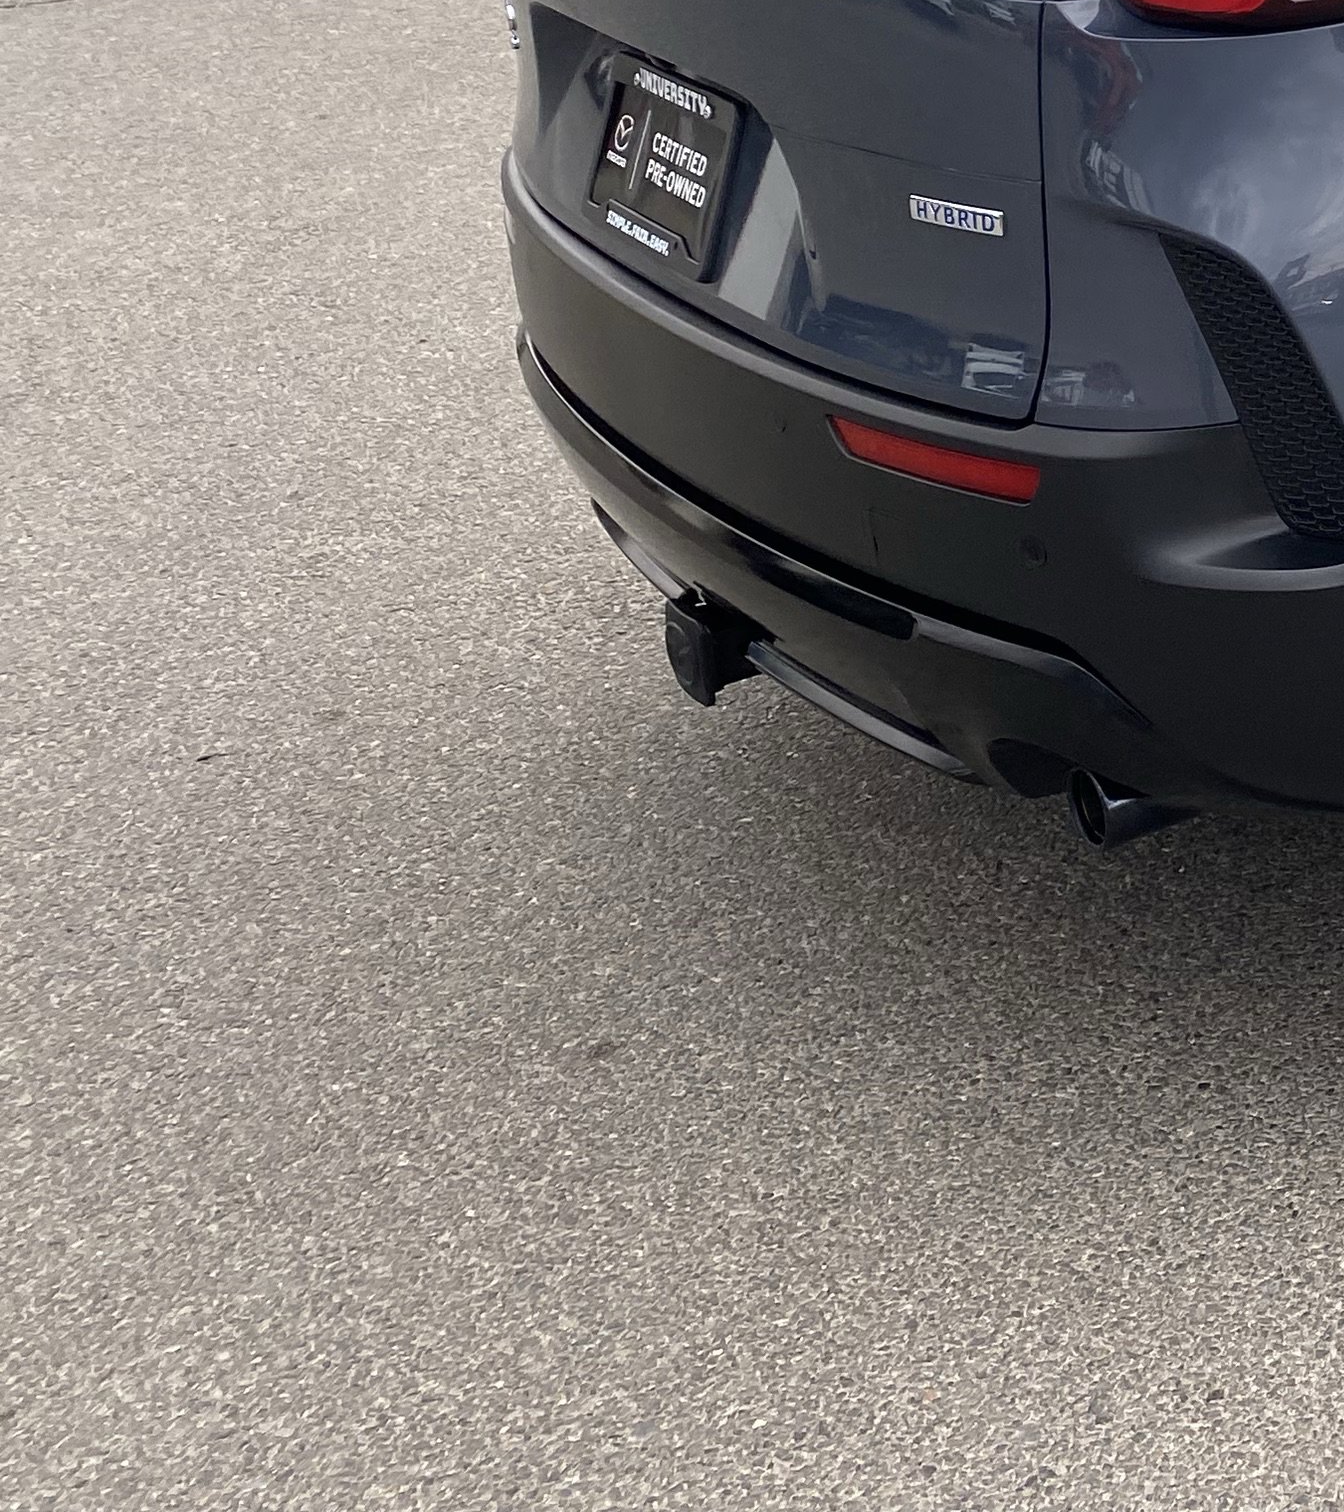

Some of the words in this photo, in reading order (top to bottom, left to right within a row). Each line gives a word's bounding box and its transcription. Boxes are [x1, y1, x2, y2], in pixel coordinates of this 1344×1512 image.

[639, 67, 708, 116] UNIVERSITY
[652, 132, 708, 177] CERTIFIED
[644, 158, 706, 208] PRE-OWNED
[915, 200, 995, 232] HYBRID
